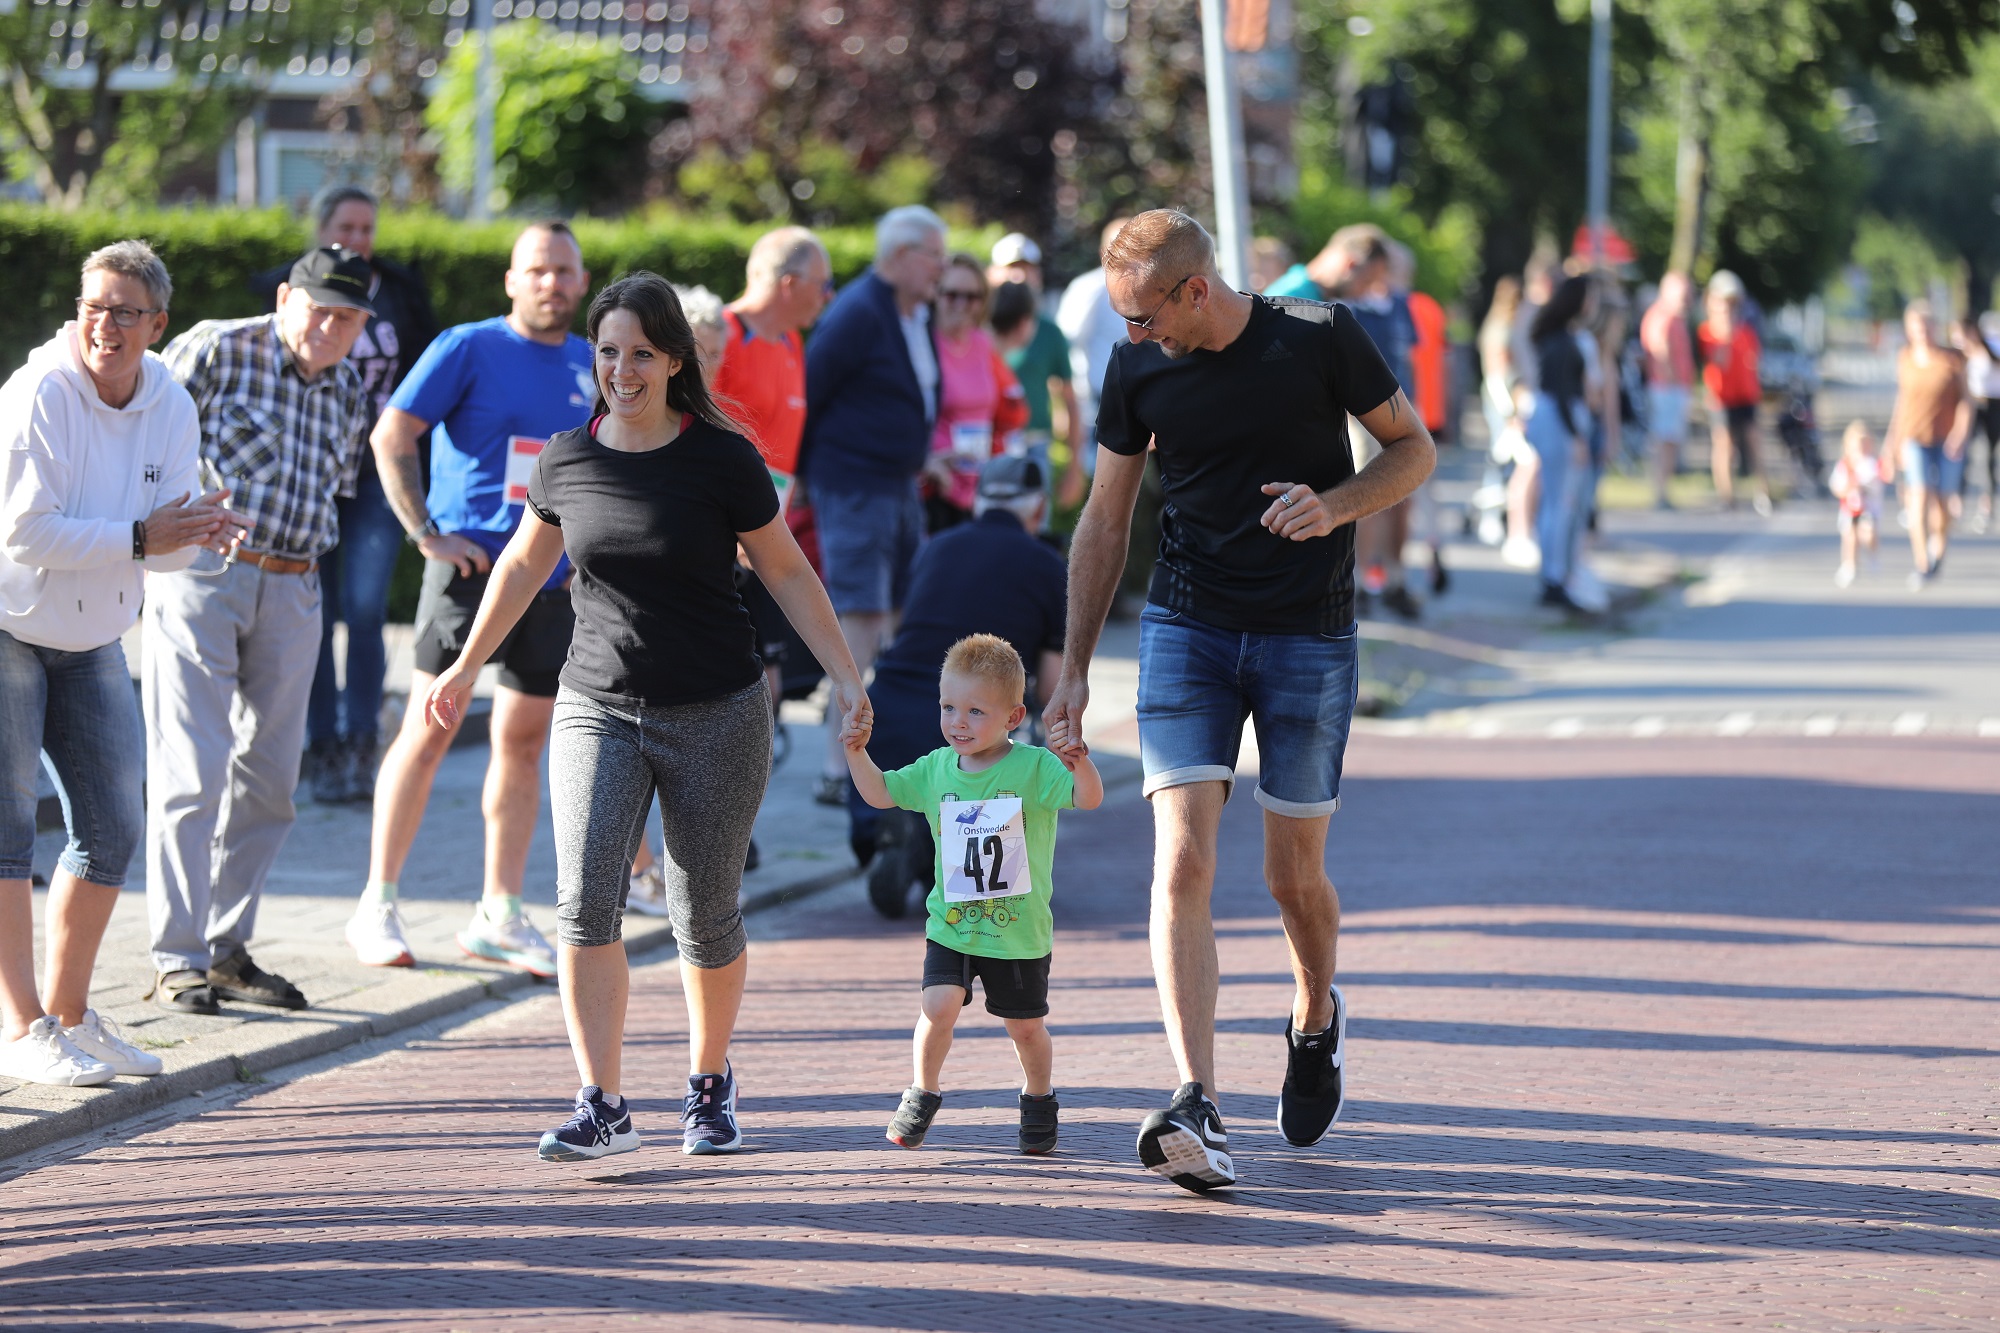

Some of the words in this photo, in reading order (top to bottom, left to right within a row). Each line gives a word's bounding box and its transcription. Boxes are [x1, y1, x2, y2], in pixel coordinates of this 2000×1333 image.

[1261, 351, 1293, 362] adidas
[963, 824, 1010, 836] Onstwedde
[963, 834, 1009, 893] 42
